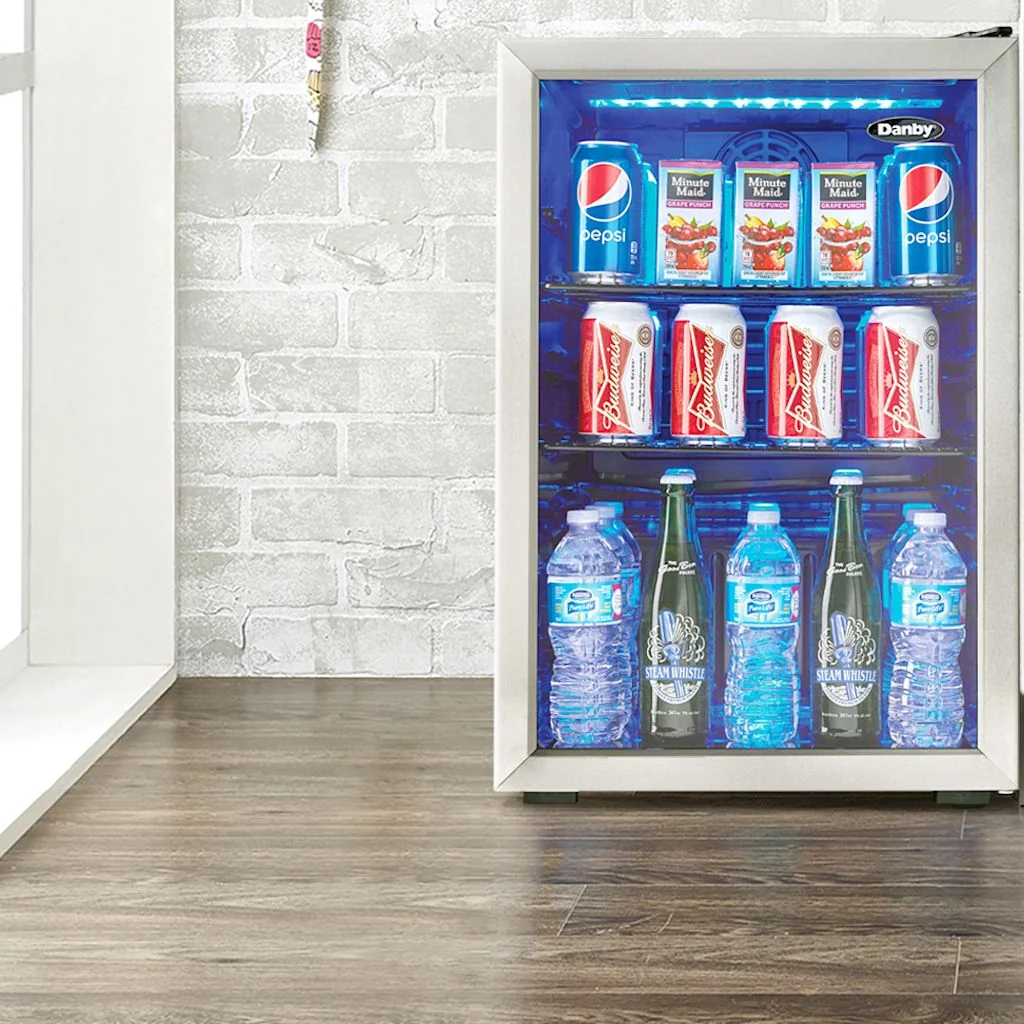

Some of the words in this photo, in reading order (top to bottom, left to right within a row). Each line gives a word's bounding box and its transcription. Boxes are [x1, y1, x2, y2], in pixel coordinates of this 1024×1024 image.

[877, 123, 934, 139] Danby
[671, 176, 710, 188] Minute
[748, 177, 787, 189] Minute
[824, 177, 863, 189] Minute
[676, 186, 705, 197] Maid
[753, 186, 782, 198] Maid
[829, 187, 858, 198] Maid
[744, 201, 766, 209] GRAPE
[766, 201, 789, 209] PUNCH
[581, 228, 626, 245] pepsi
[904, 229, 951, 247] pepsi
[645, 666, 670, 679] STEAM
[671, 667, 705, 680] WHISTLE
[816, 669, 842, 682] STEAM
[842, 669, 877, 682] WHISTLE
